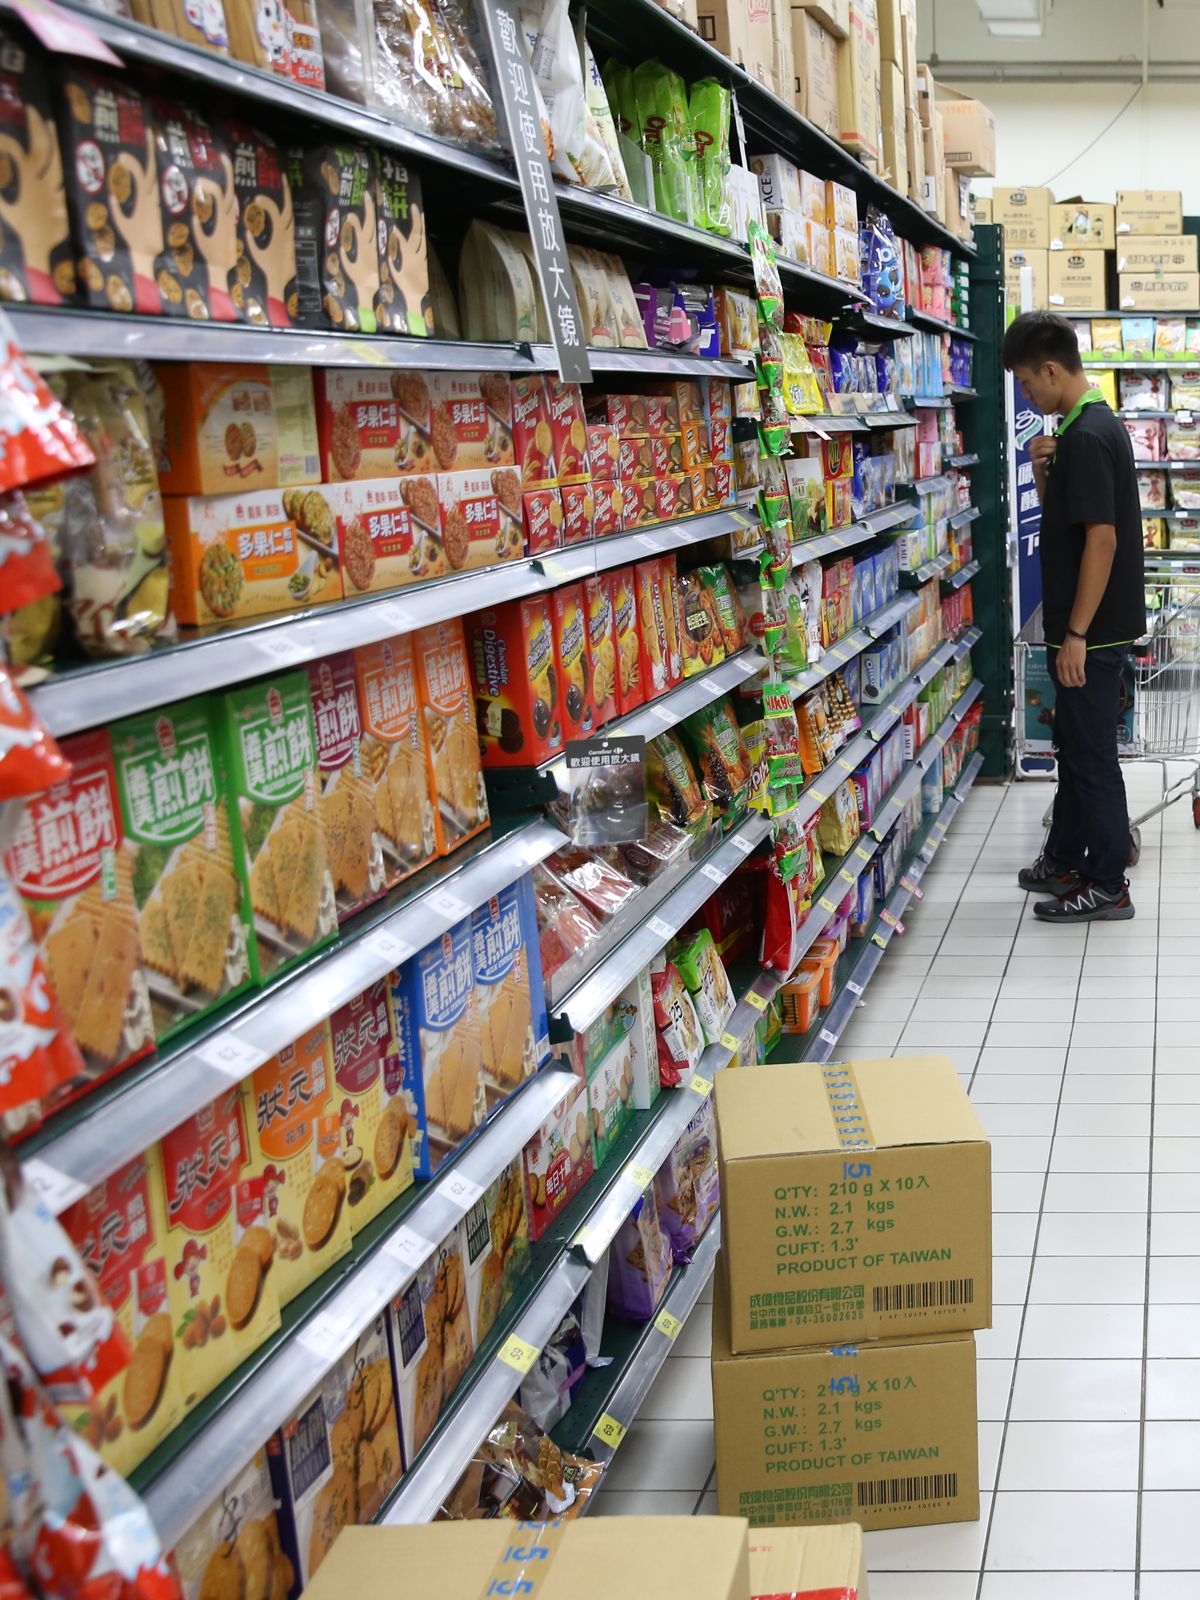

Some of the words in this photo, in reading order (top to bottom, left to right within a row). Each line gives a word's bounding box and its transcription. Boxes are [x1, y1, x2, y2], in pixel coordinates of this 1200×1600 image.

[495, 9, 580, 347] 歡迎使用放大鏡
[482, 628, 500, 698] Digestive
[570, 752, 641, 768] 歡迎使用放大鏡
[774, 1185, 818, 1201] Q'TY:
[829, 1181, 858, 1197] 210
[830, 1201, 853, 1216] 2.1
[866, 1199, 895, 1213] kgs
[830, 1220, 854, 1235] 2.7
[866, 1217, 895, 1232] kgs
[776, 1241, 825, 1257] CUFT:
[776, 1256, 858, 1276] PRODUCT
[862, 1253, 885, 1268] OF
[889, 1247, 952, 1265] TAIWAN
[763, 1386, 807, 1402] Q'TY:
[817, 1401, 841, 1416] 2.1
[854, 1400, 882, 1413] kgs
[818, 1420, 842, 1435] 2.7
[854, 1417, 882, 1431] kgs
[765, 1441, 814, 1456] CUFT:
[765, 1455, 845, 1474] PRODUCT
[851, 1452, 873, 1467] OF
[878, 1446, 939, 1464] TAIWAN
